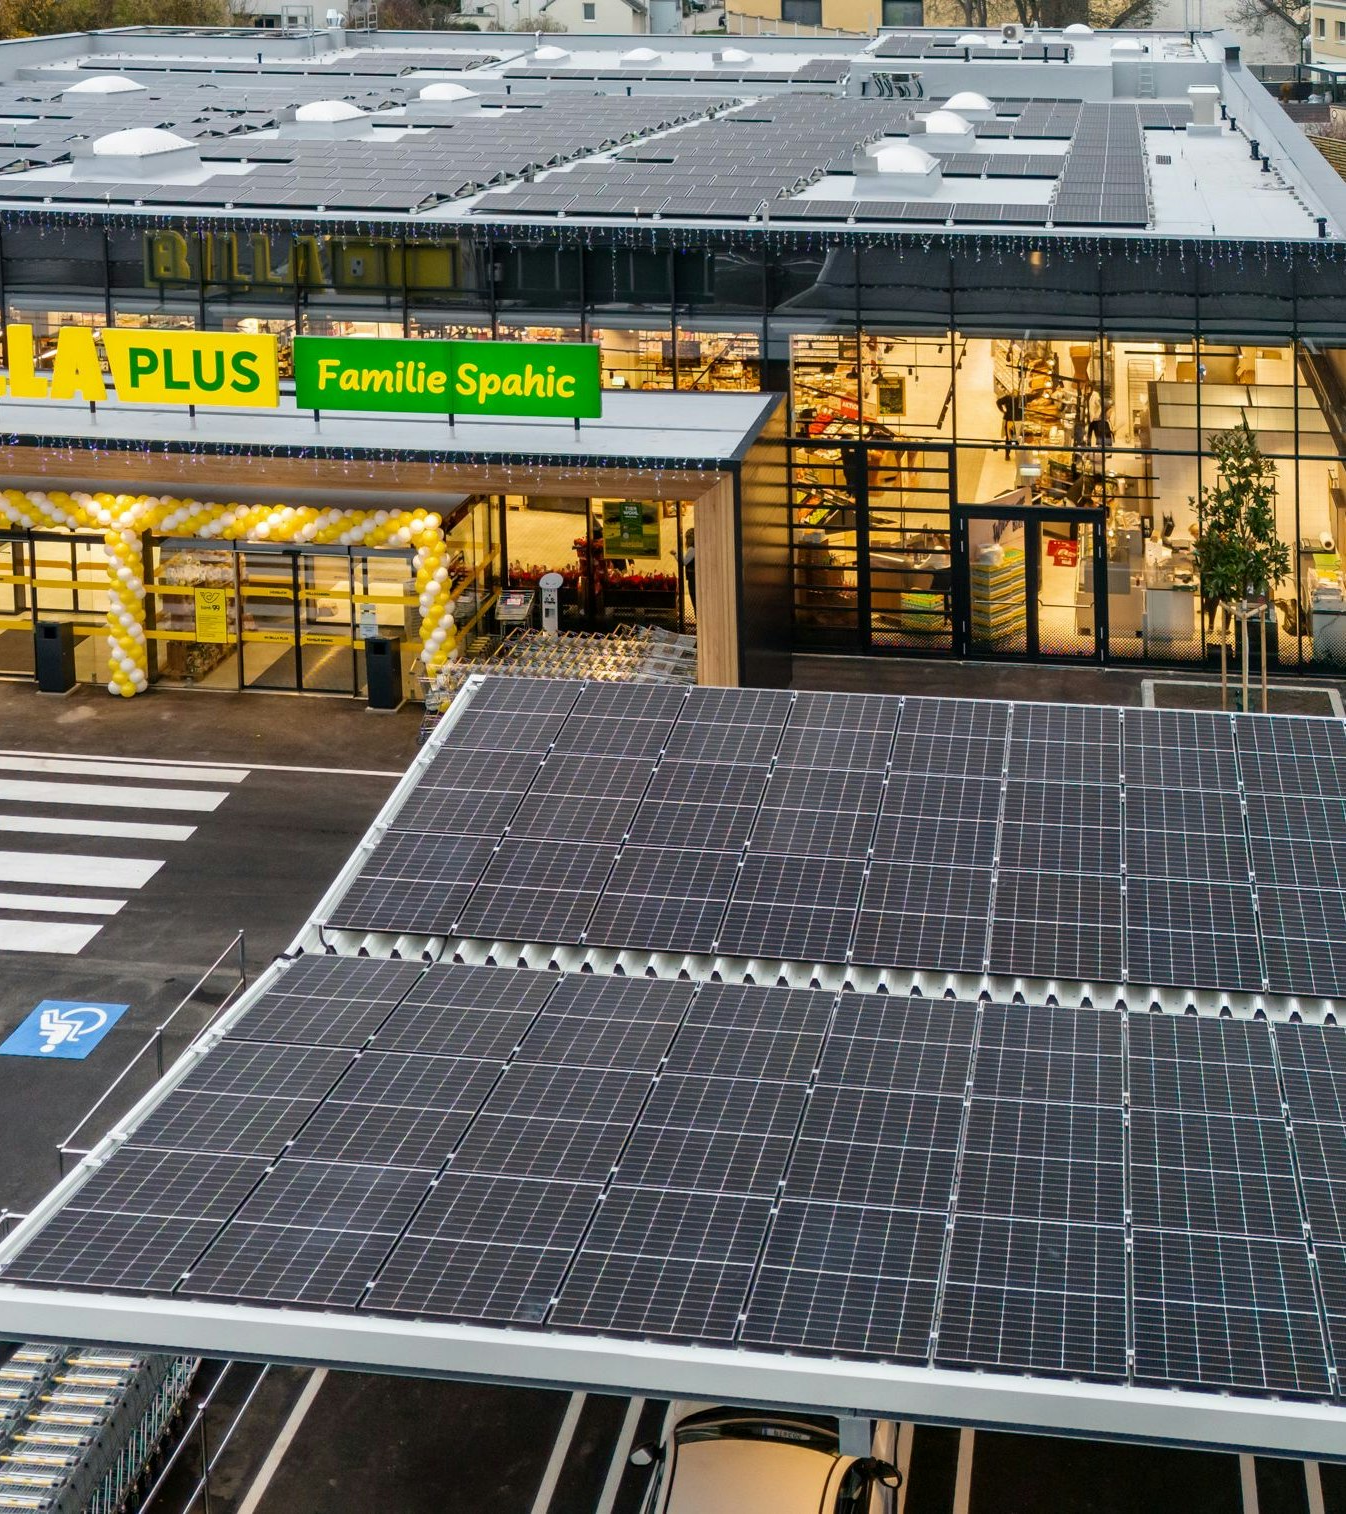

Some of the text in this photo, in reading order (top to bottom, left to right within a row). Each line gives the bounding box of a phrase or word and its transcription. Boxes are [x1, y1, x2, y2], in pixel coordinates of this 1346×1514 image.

[129, 347, 260, 393] PLUS
[318, 359, 576, 404] Familie Spahic
